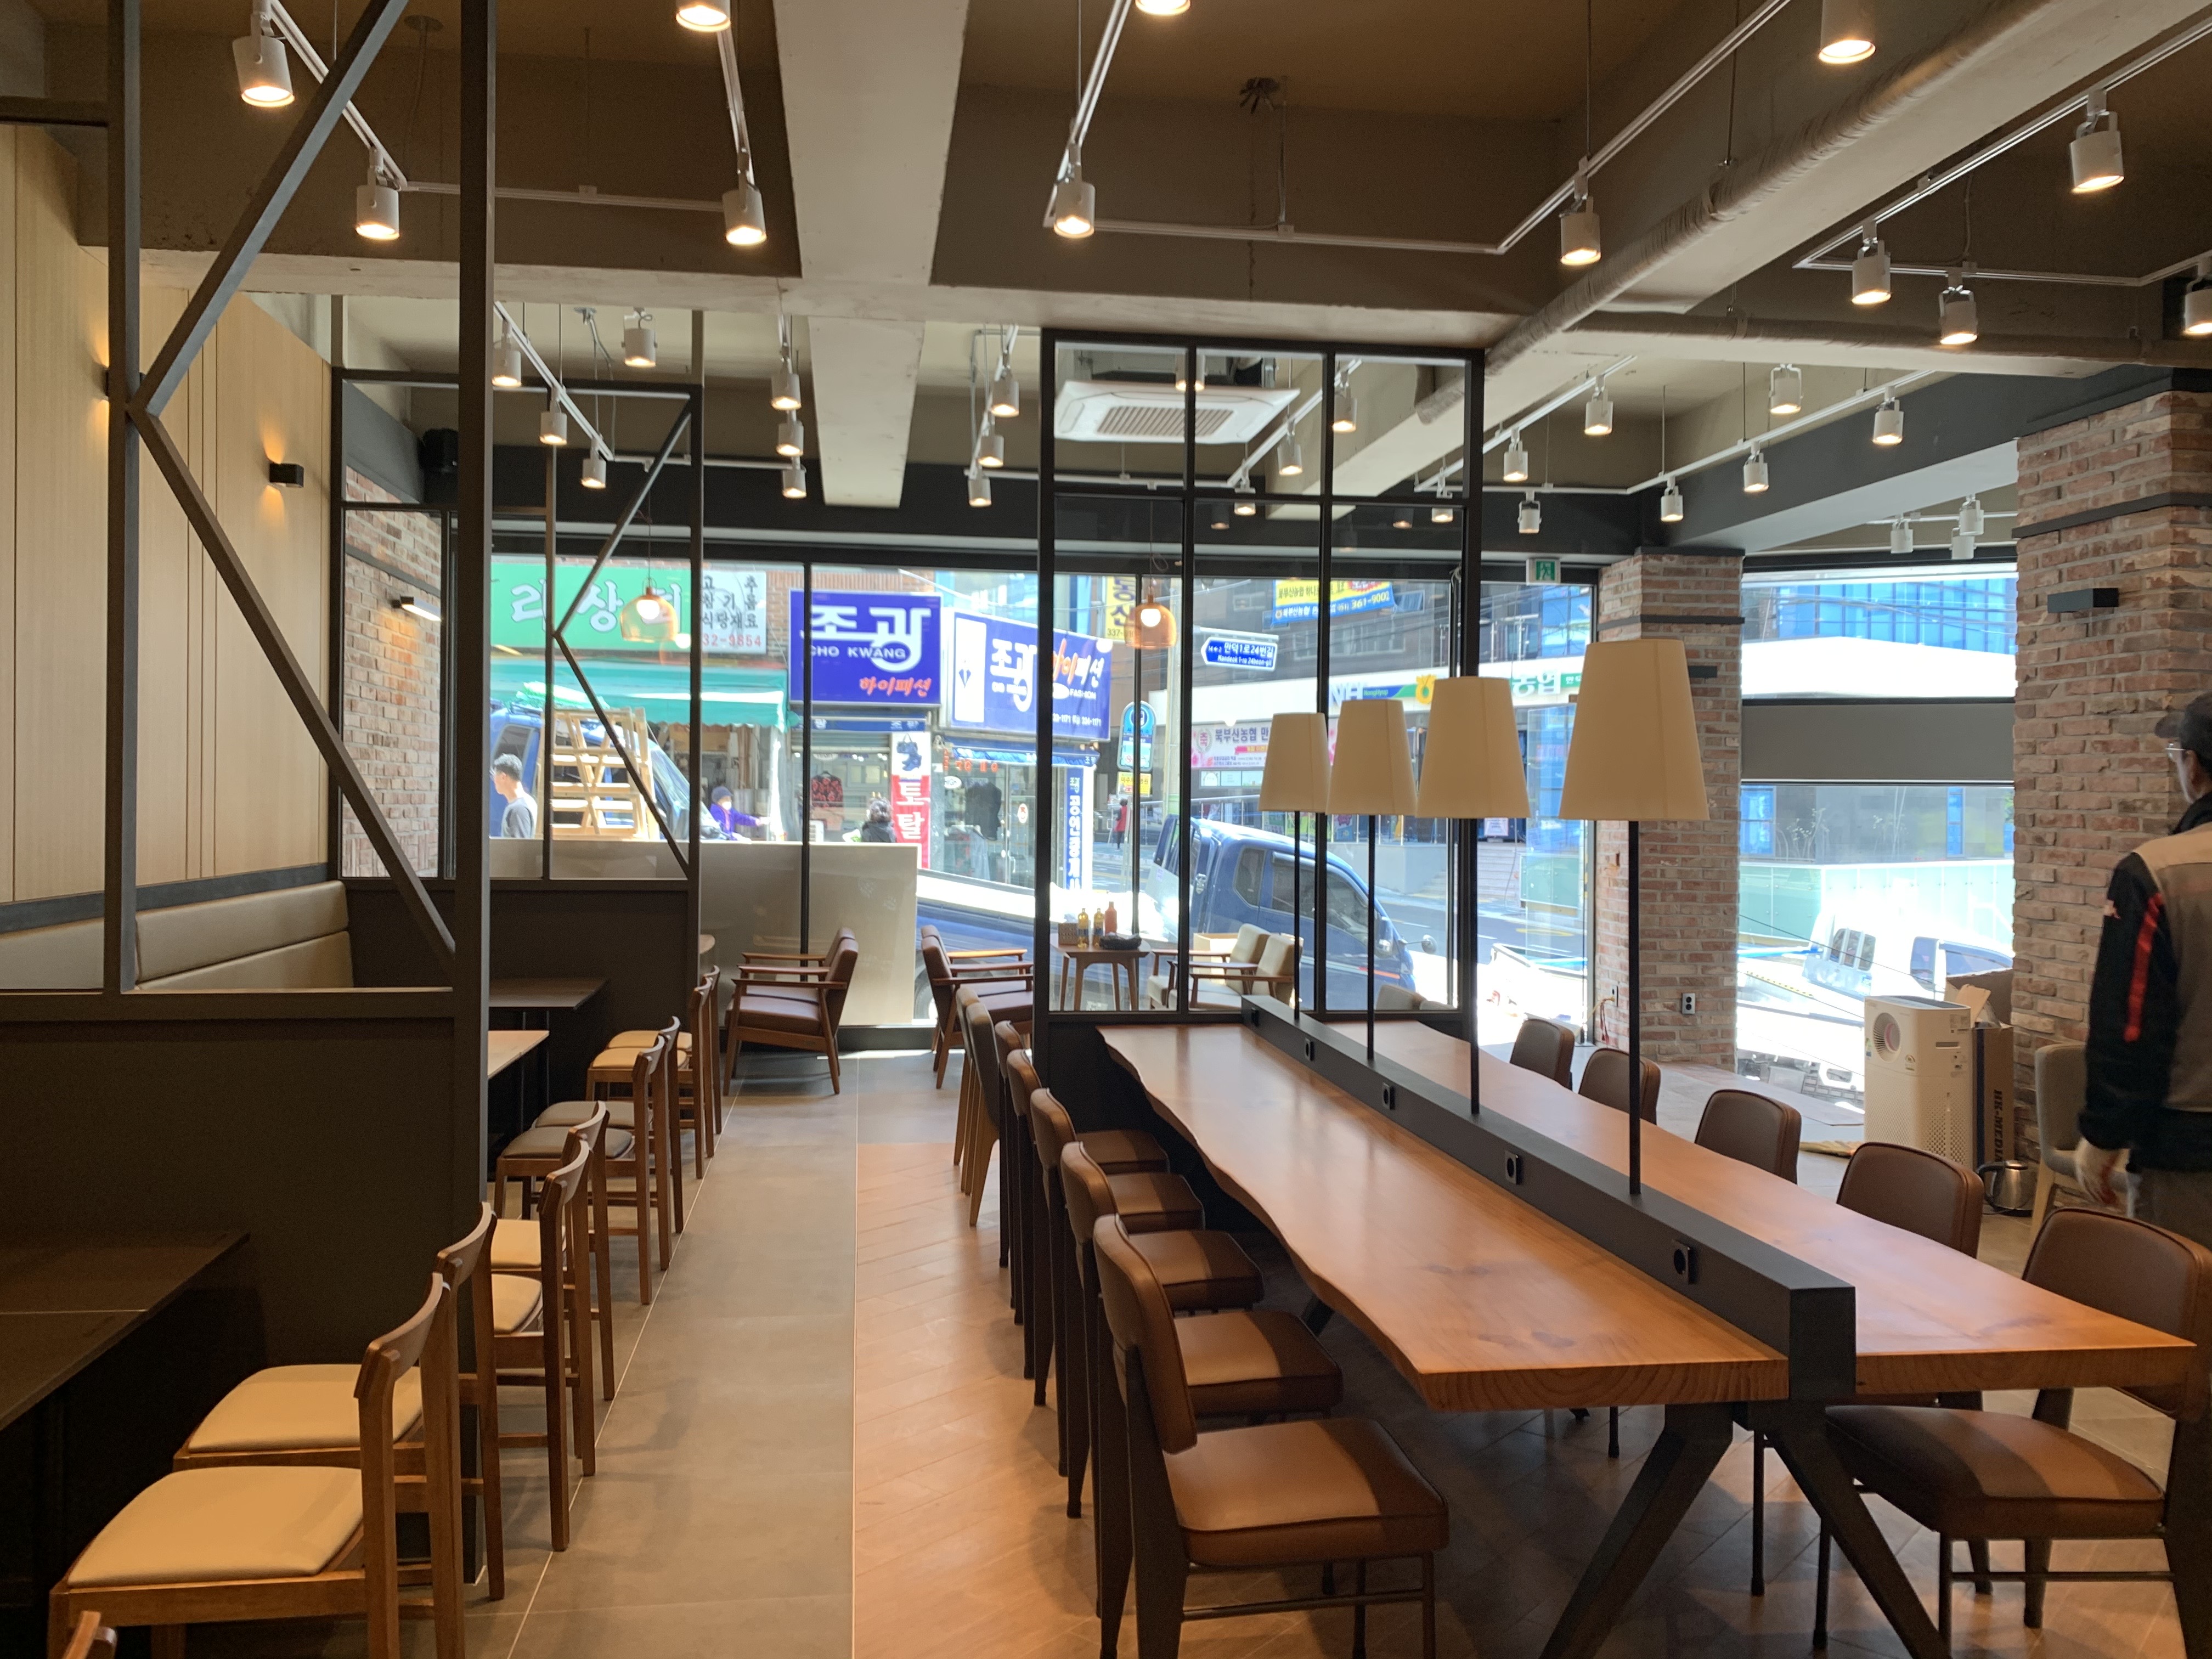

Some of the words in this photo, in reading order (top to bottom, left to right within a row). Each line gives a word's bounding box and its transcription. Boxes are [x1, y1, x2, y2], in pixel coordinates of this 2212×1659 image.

[1351, 591, 1390, 609] 361-9002
[799, 605, 932, 673] 조광
[1224, 642, 1273, 658] 만덕1로24번길
[847, 647, 906, 659] KWANG
[860, 675, 932, 697] 하이패션
[1512, 672, 1561, 697] 농협
[1215, 727, 1256, 742] 북부산농협
[896, 782, 926, 839] 토탈
[1994, 1089, 2002, 1162] HK-MEDIA
